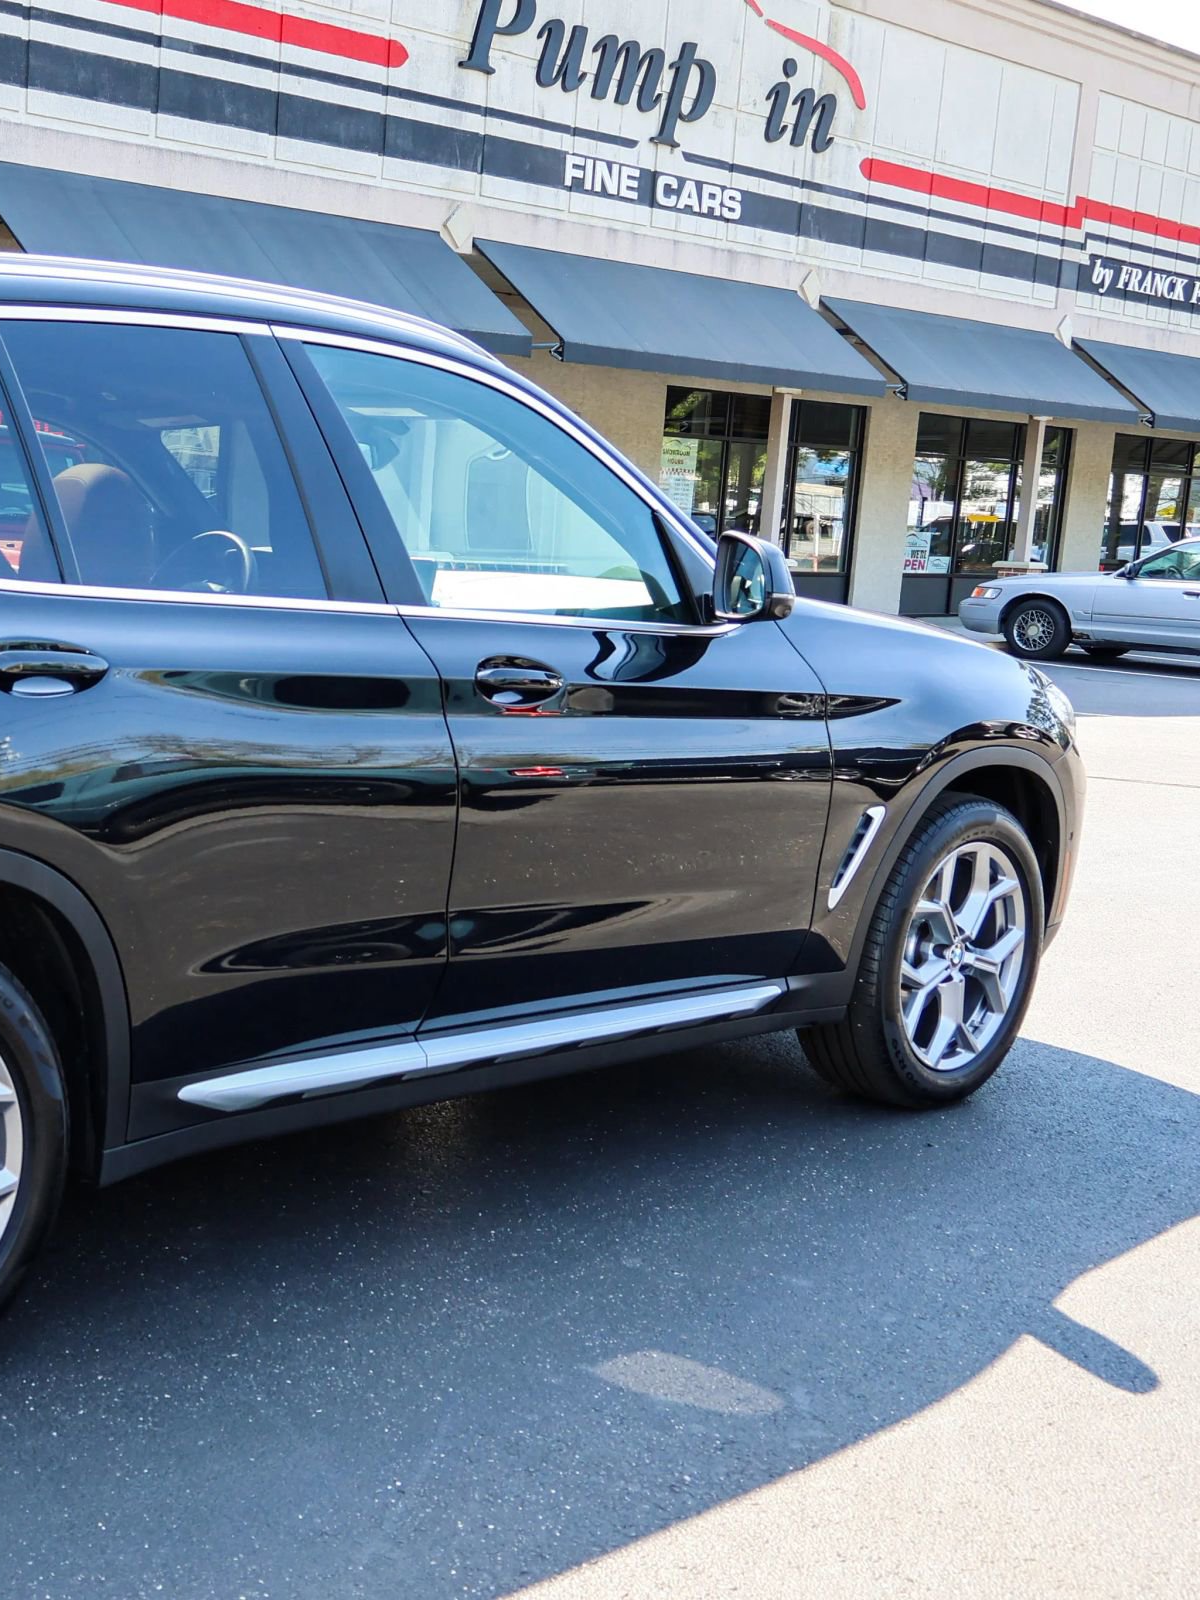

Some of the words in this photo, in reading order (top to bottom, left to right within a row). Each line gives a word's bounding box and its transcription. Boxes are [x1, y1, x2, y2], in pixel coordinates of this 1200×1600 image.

[458, 0, 717, 148] Pump
[764, 57, 838, 154] in
[564, 154, 640, 200] FINE
[655, 175, 743, 220] CARS
[1091, 259, 1114, 293] by
[1116, 265, 1189, 302] FRANCK
[903, 559, 926, 571] PEN
